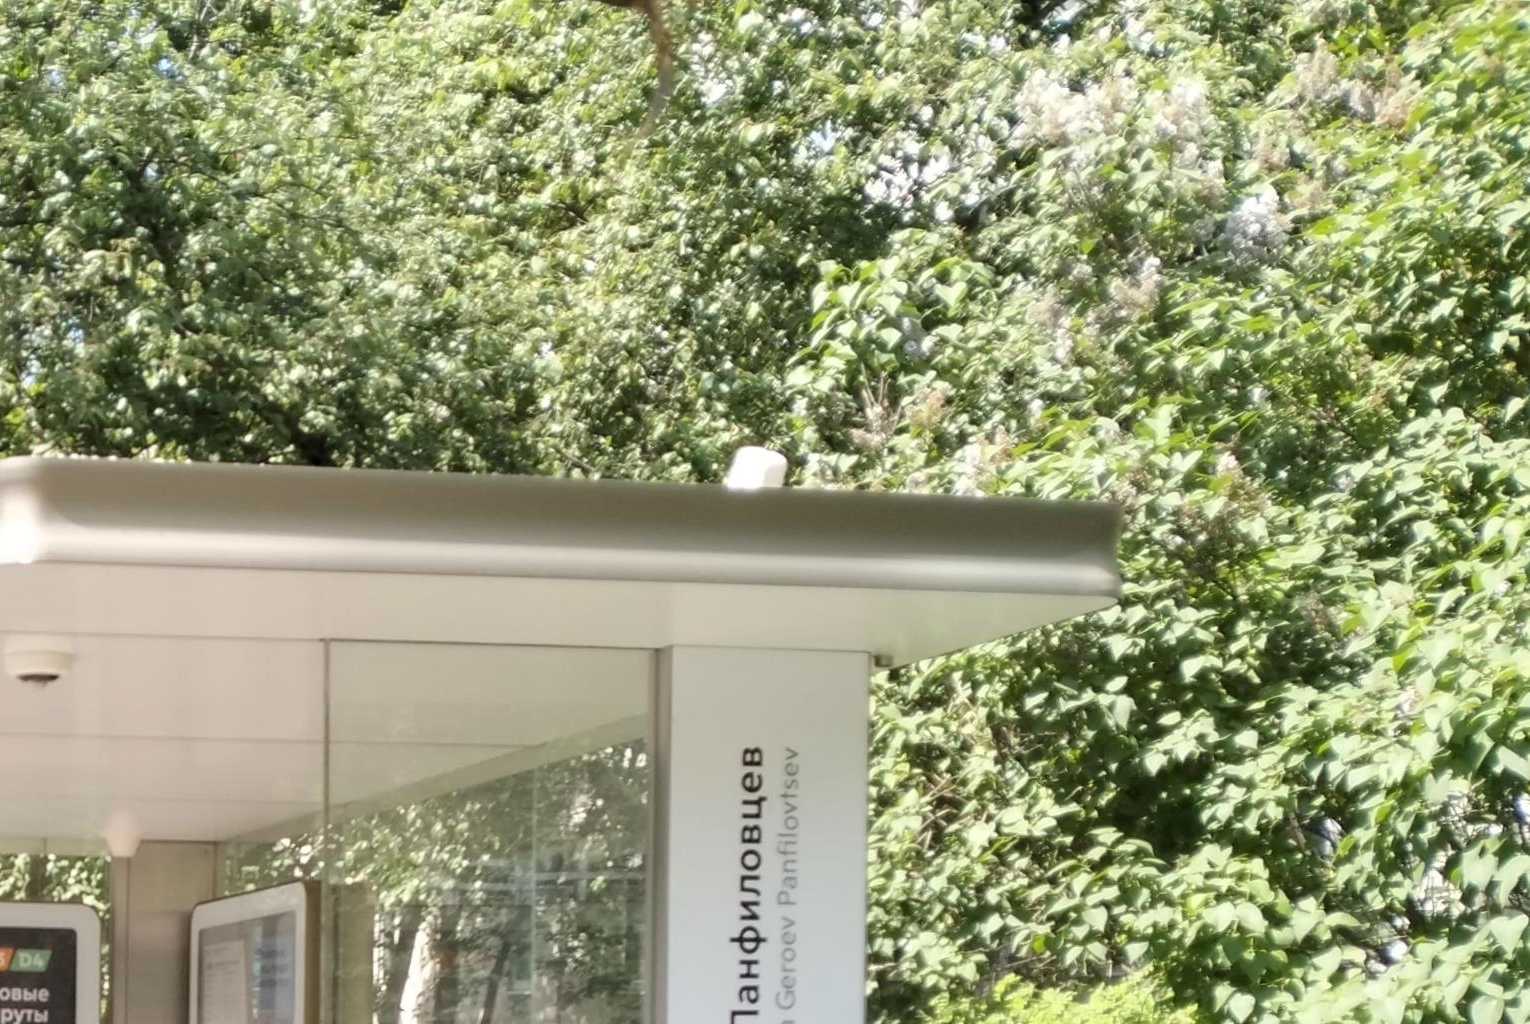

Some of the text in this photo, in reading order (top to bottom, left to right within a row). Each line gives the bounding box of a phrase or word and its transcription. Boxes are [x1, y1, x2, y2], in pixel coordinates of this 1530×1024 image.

[776, 747, 800, 906] Panfilovtsev
[19, 953, 45, 969] D4
[774, 916, 798, 1010] Geroev
